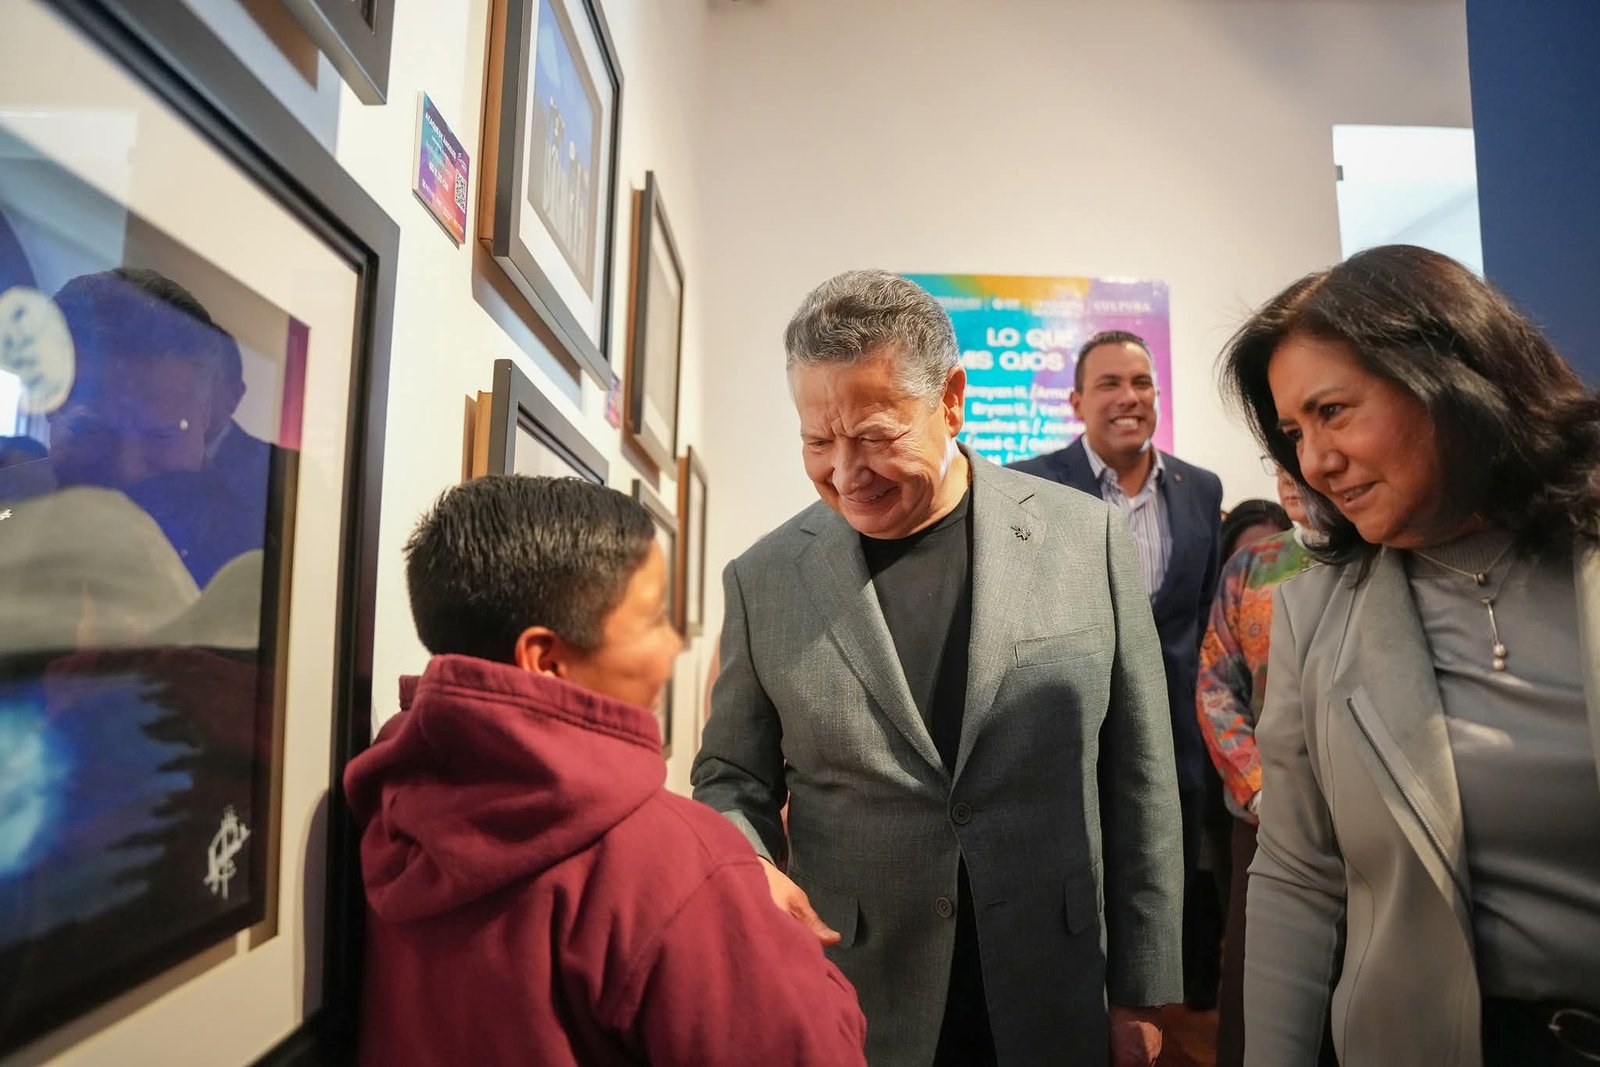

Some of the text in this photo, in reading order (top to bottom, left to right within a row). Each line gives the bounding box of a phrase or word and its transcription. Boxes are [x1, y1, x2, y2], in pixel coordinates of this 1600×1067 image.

[1094, 299, 1152, 313] CULTURA
[986, 327, 1021, 347] LO
[998, 351, 1065, 371] OJOS
